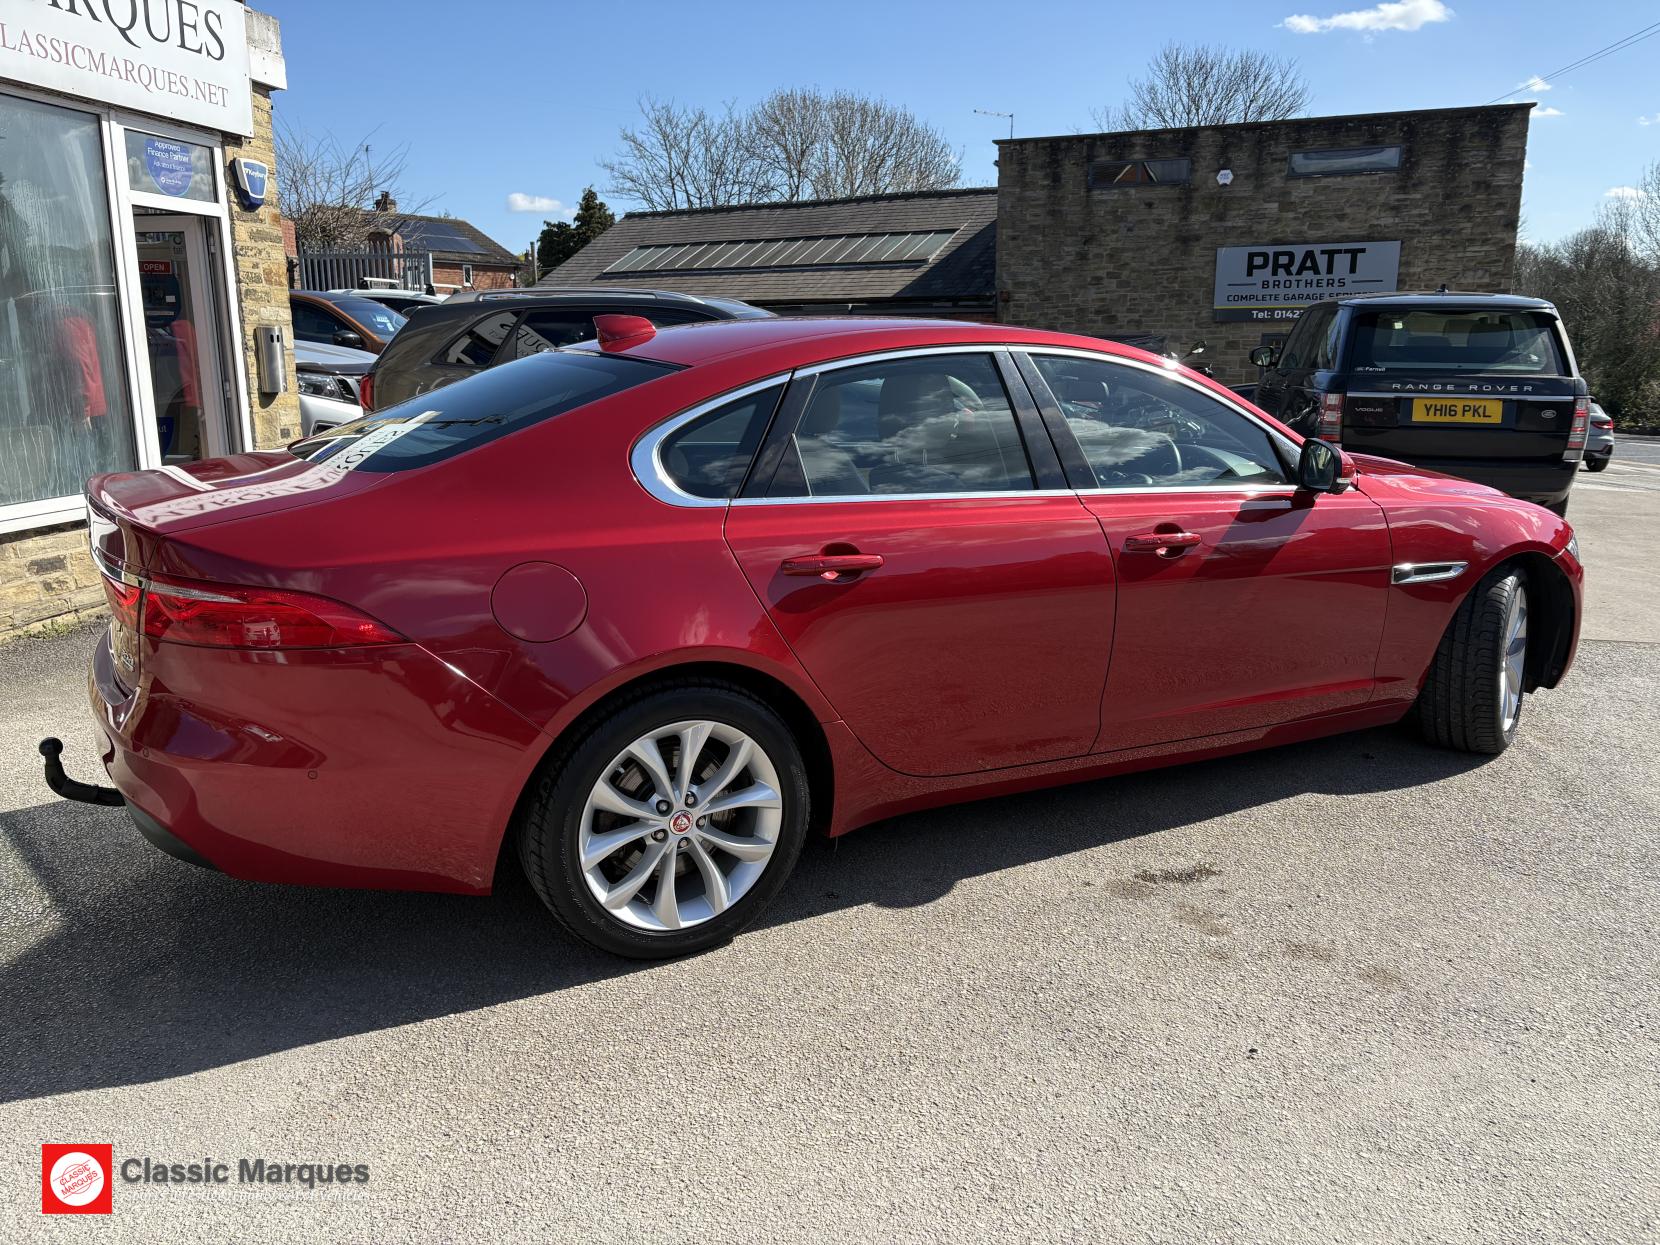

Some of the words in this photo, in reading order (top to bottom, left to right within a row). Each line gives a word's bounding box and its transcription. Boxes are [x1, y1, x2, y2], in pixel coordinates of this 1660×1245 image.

[154, 140, 181, 152] Approved
[147, 147, 169, 159] Finance
[170, 151, 189, 163] Partner
[143, 263, 165, 271] OPEN
[1246, 248, 1367, 277] PRATT
[1261, 278, 1346, 289] BROTHERS
[1226, 294, 1280, 302] COMPLETE
[1283, 292, 1325, 301] GARAGE
[1252, 310, 1271, 319] Tel:
[1274, 310, 1304, 319] 0142
[1392, 383, 1455, 391] RANGE
[1468, 384, 1533, 392] ROVER
[1424, 403, 1458, 417] YH16
[1462, 404, 1492, 418] PKL
